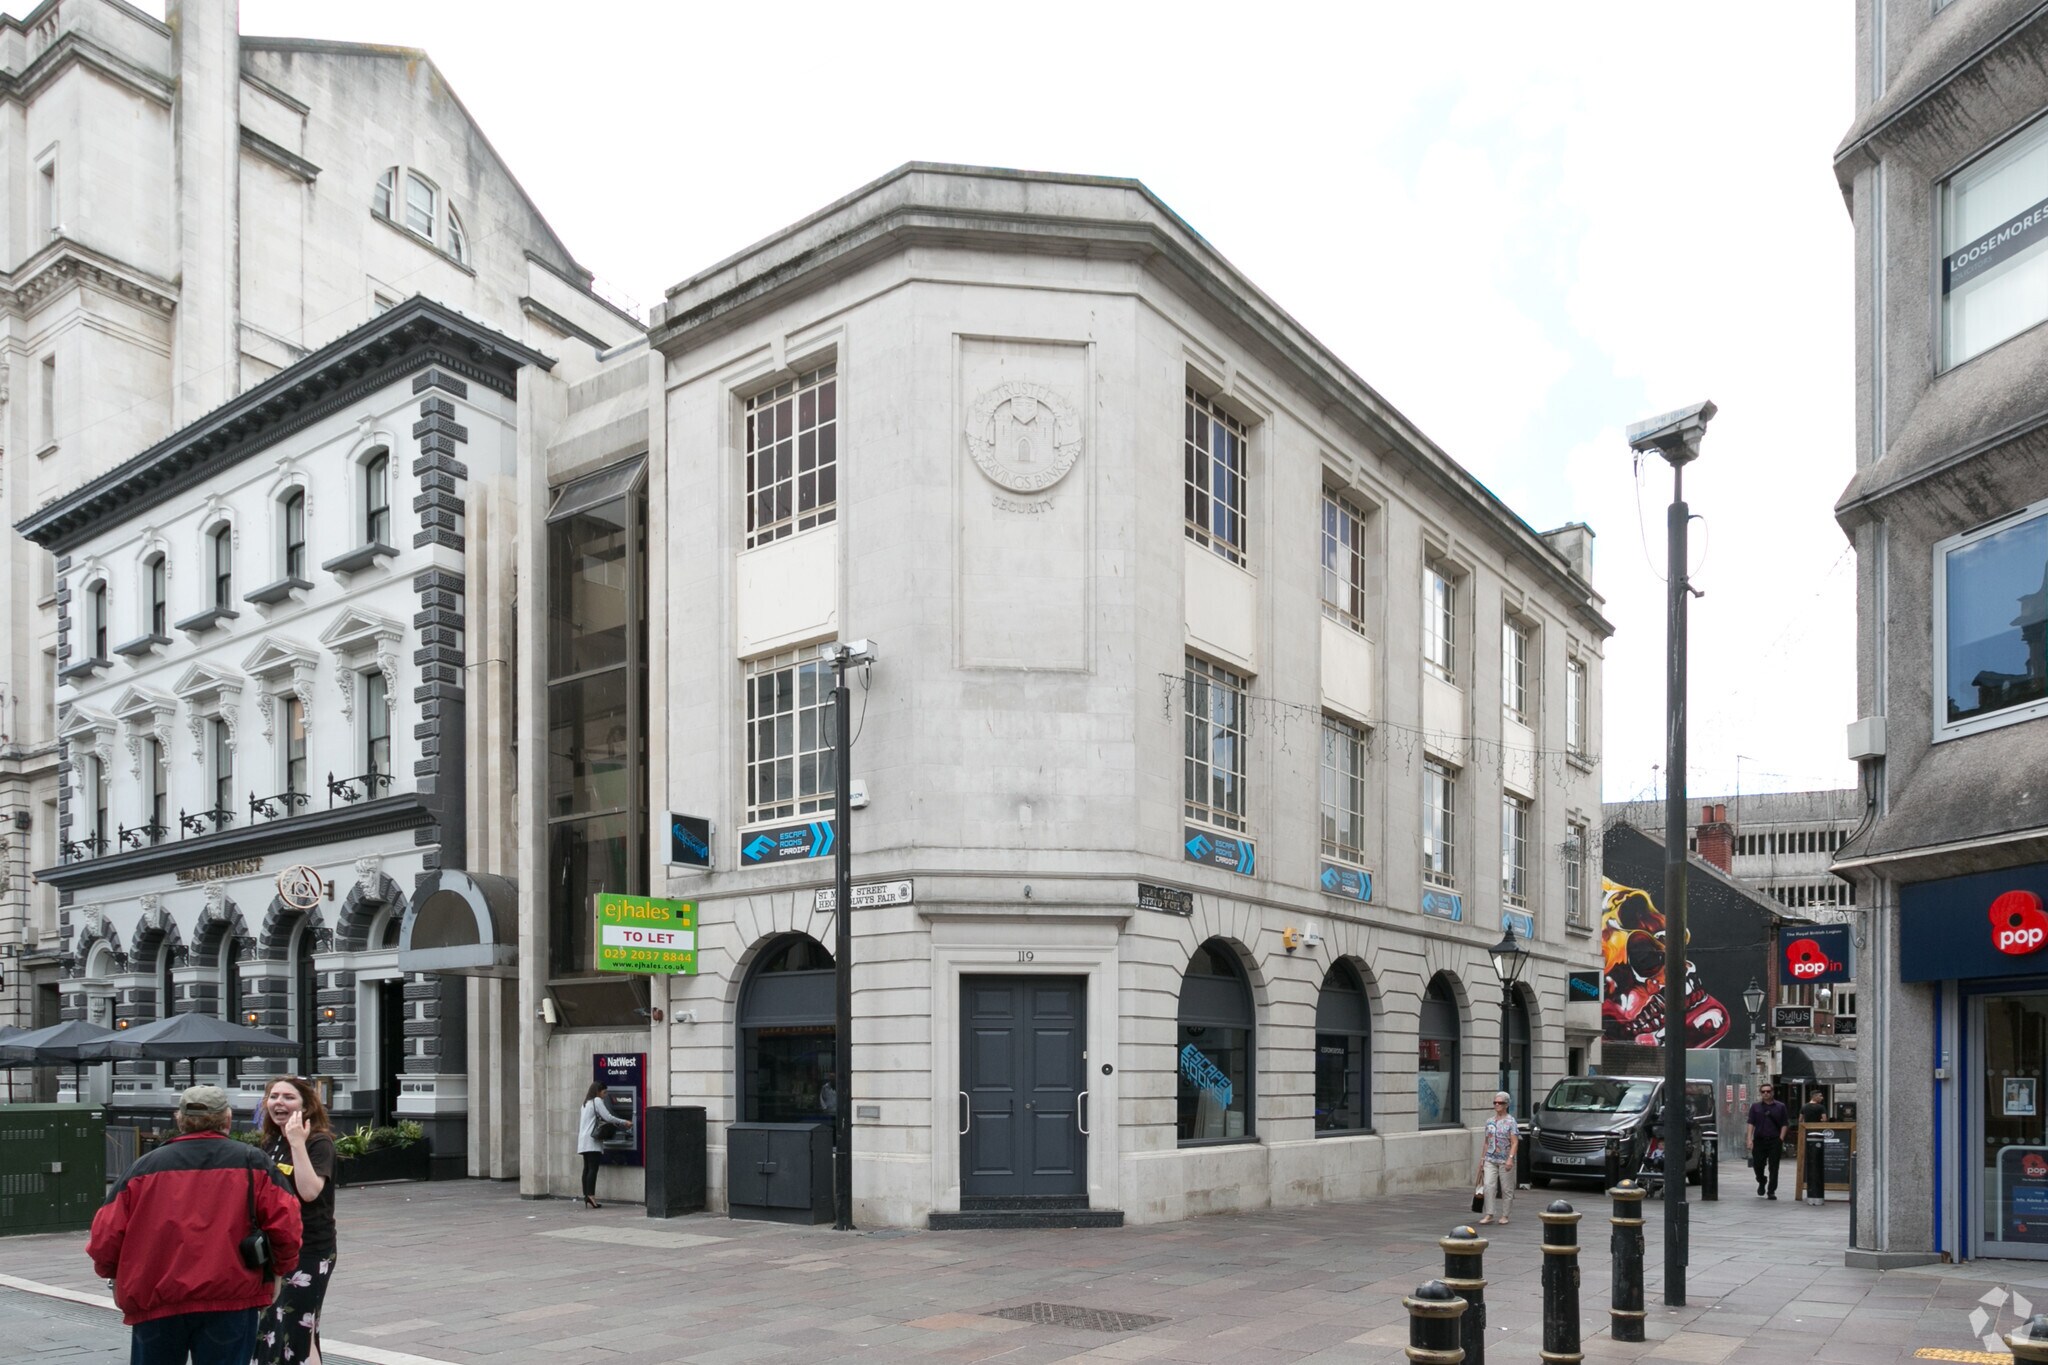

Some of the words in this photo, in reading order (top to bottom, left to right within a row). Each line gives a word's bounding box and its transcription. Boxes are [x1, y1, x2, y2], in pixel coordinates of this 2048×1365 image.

[1951, 204, 2048, 273] LOOSEMORES
[993, 381, 1055, 401] TRUSTEE
[983, 458, 1031, 489] SAVINGS
[1034, 459, 1069, 488] BANK
[992, 496, 1055, 514] SECURITY
[780, 830, 807, 839] ESCAPE
[779, 845, 810, 856] CARDIFF
[780, 839, 802, 847] ROOMS
[193, 857, 264, 882] ALCHEMIST
[818, 892, 828, 900] ST
[856, 885, 887, 896] STREET
[818, 900, 836, 909] HEO
[877, 893, 896, 903] FAIR
[605, 899, 670, 922] ejhales
[623, 931, 643, 942] TO
[648, 933, 675, 944] LET
[2000, 928, 2043, 950] pop
[604, 948, 627, 959] 029
[631, 950, 659, 960] 2037
[663, 952, 692, 962] 8844
[1018, 950, 1034, 962] 119
[612, 961, 684, 970] www.ejhales.co.uk
[1794, 962, 1825, 976] pop
[1830, 960, 1842, 971] in
[1777, 1010, 1809, 1022] Sully's
[607, 1057, 636, 1067] NatWest
[1181, 1043, 1232, 1089] ESCAPE
[1181, 1053, 1224, 1106] ROOMS
[2027, 1167, 2047, 1176] pop
